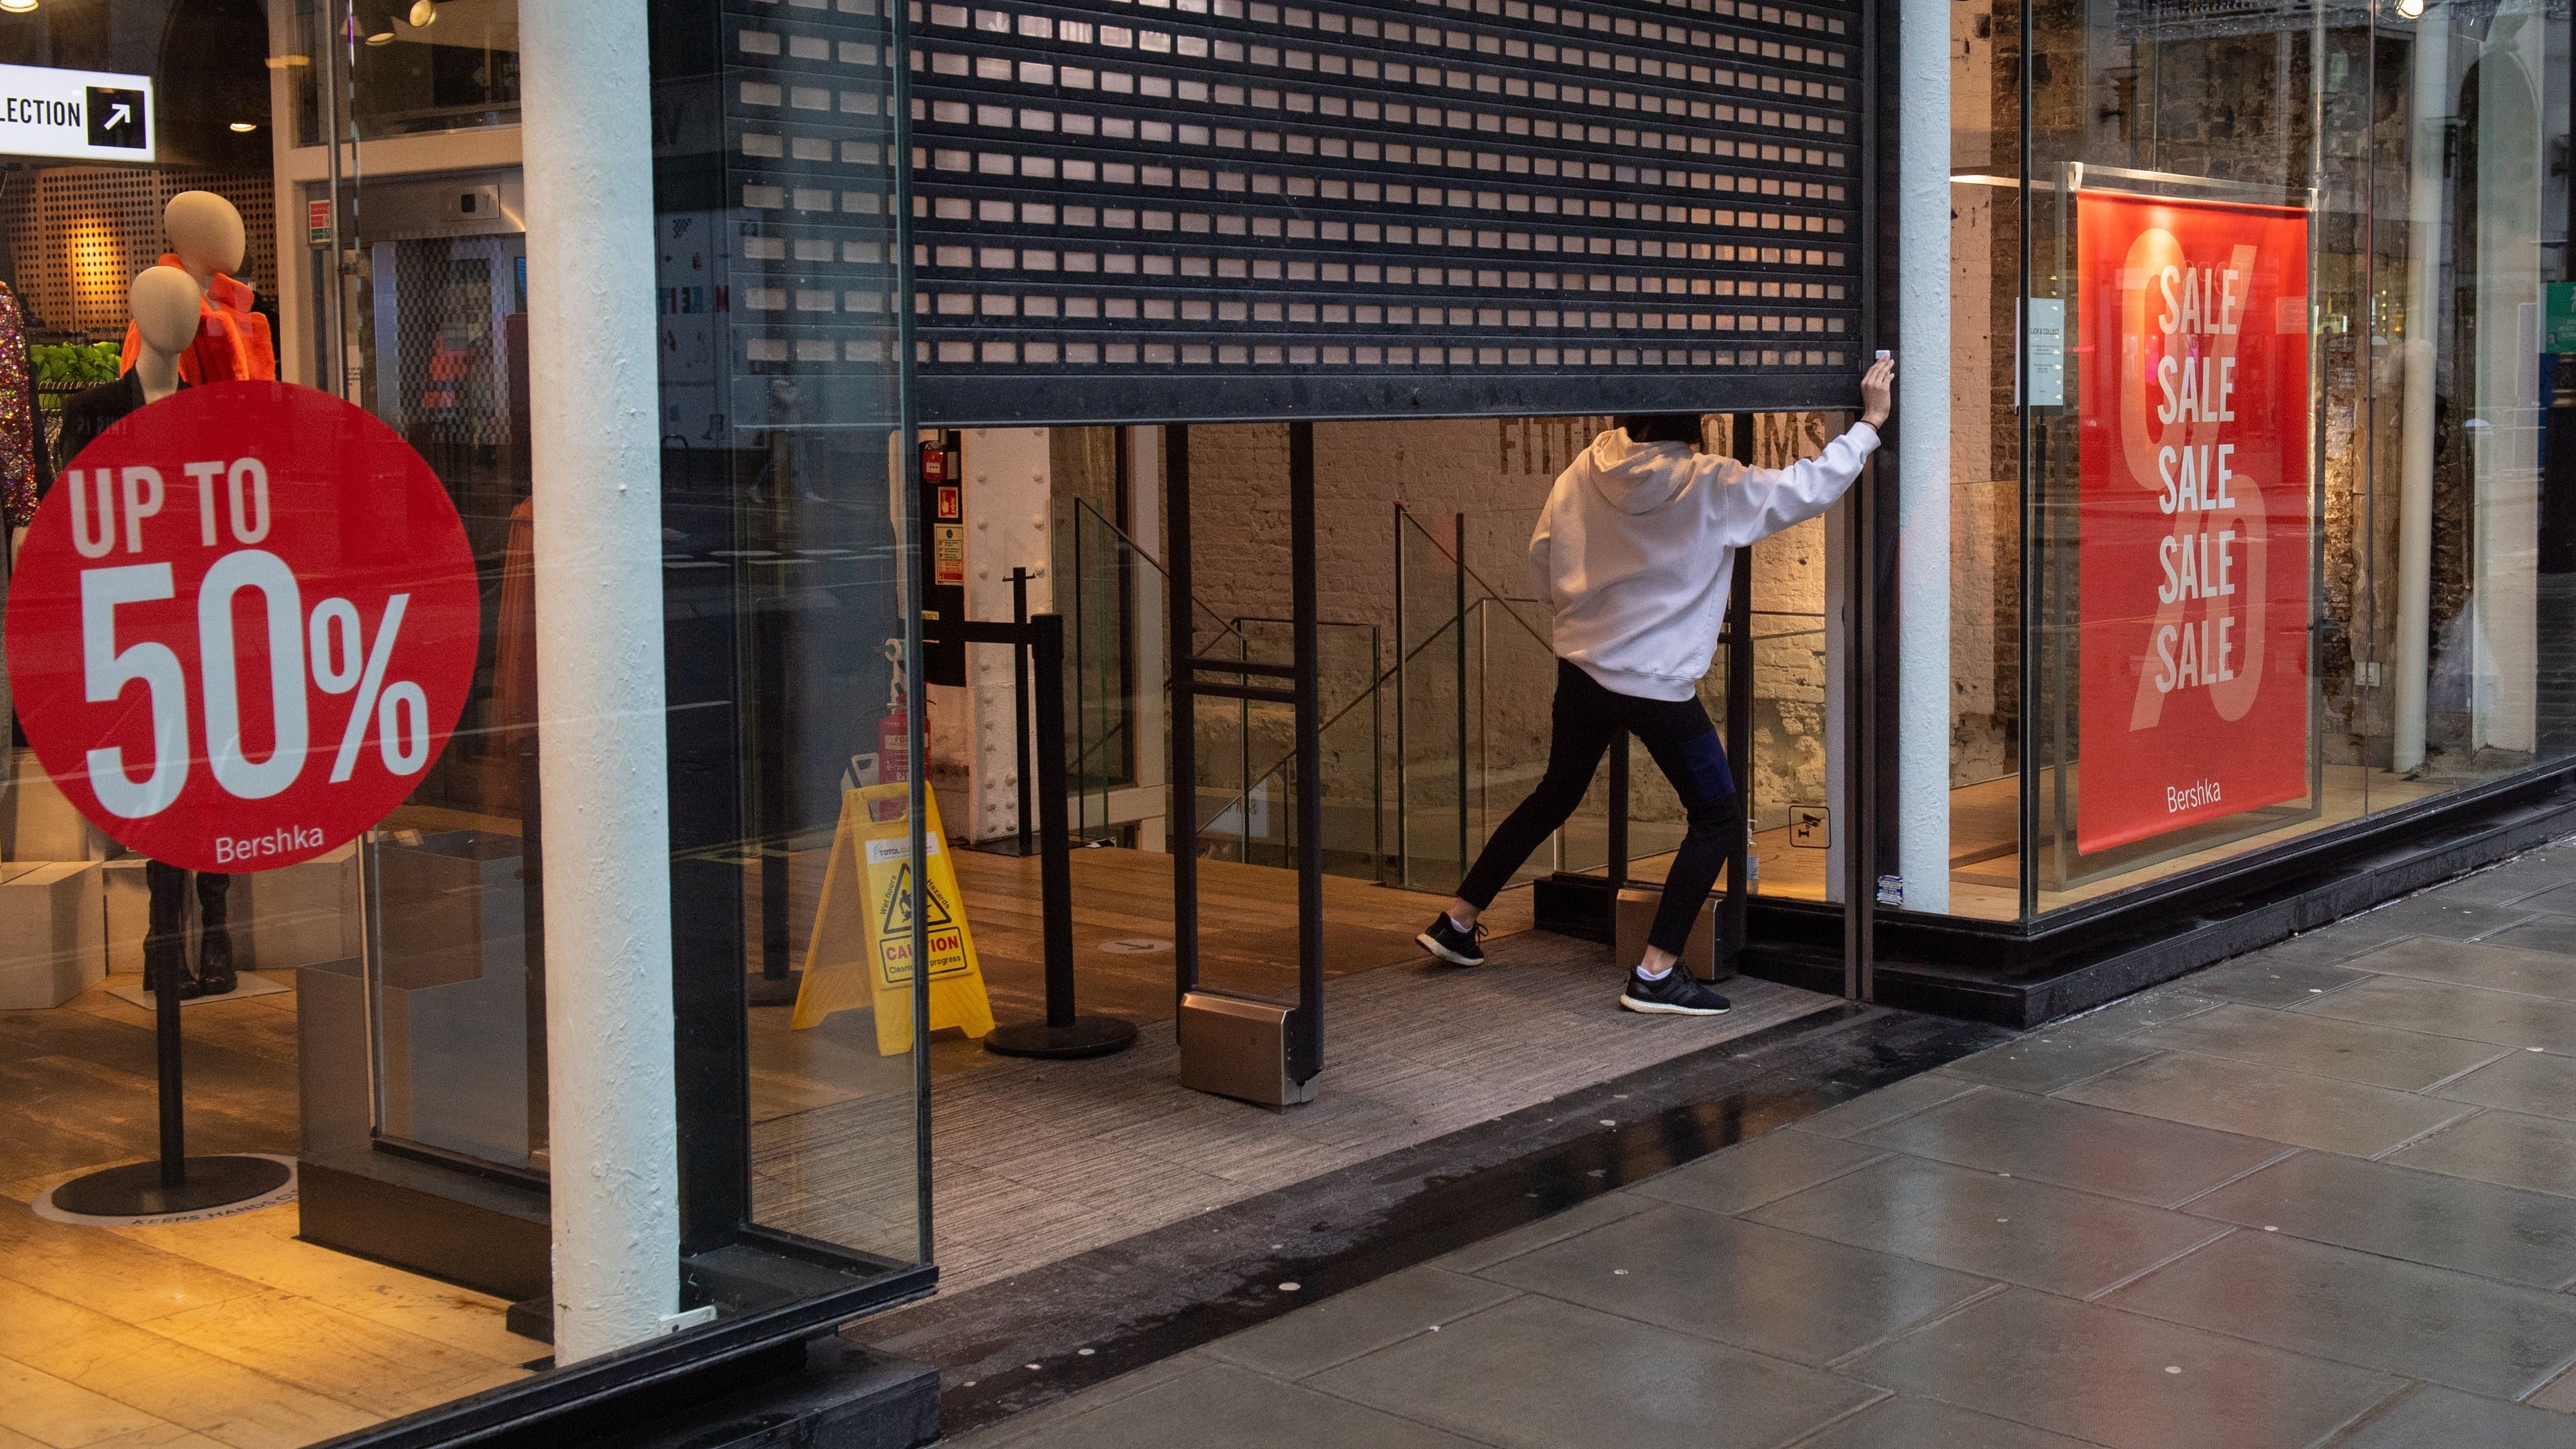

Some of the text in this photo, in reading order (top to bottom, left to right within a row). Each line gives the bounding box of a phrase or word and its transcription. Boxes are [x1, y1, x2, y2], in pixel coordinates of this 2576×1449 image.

[2158, 264, 2239, 335] SALE
[2157, 355, 2236, 425] SALE
[1499, 417, 1609, 475] FITTI
[68, 457, 270, 559] UP TO
[2158, 443, 2236, 515] SALE
[2158, 530, 2236, 604] SALE
[80, 549, 430, 819] 50%
[2155, 616, 2235, 694] SALE
[2167, 779, 2222, 813] Bershka
[215, 824, 324, 865] Bershka
[880, 875, 897, 915] Wet floors
[926, 879, 951, 909] Hazards
[885, 935, 959, 961] CAION
[930, 955, 961, 967] progress
[207, 1200, 276, 1218] HANDS
